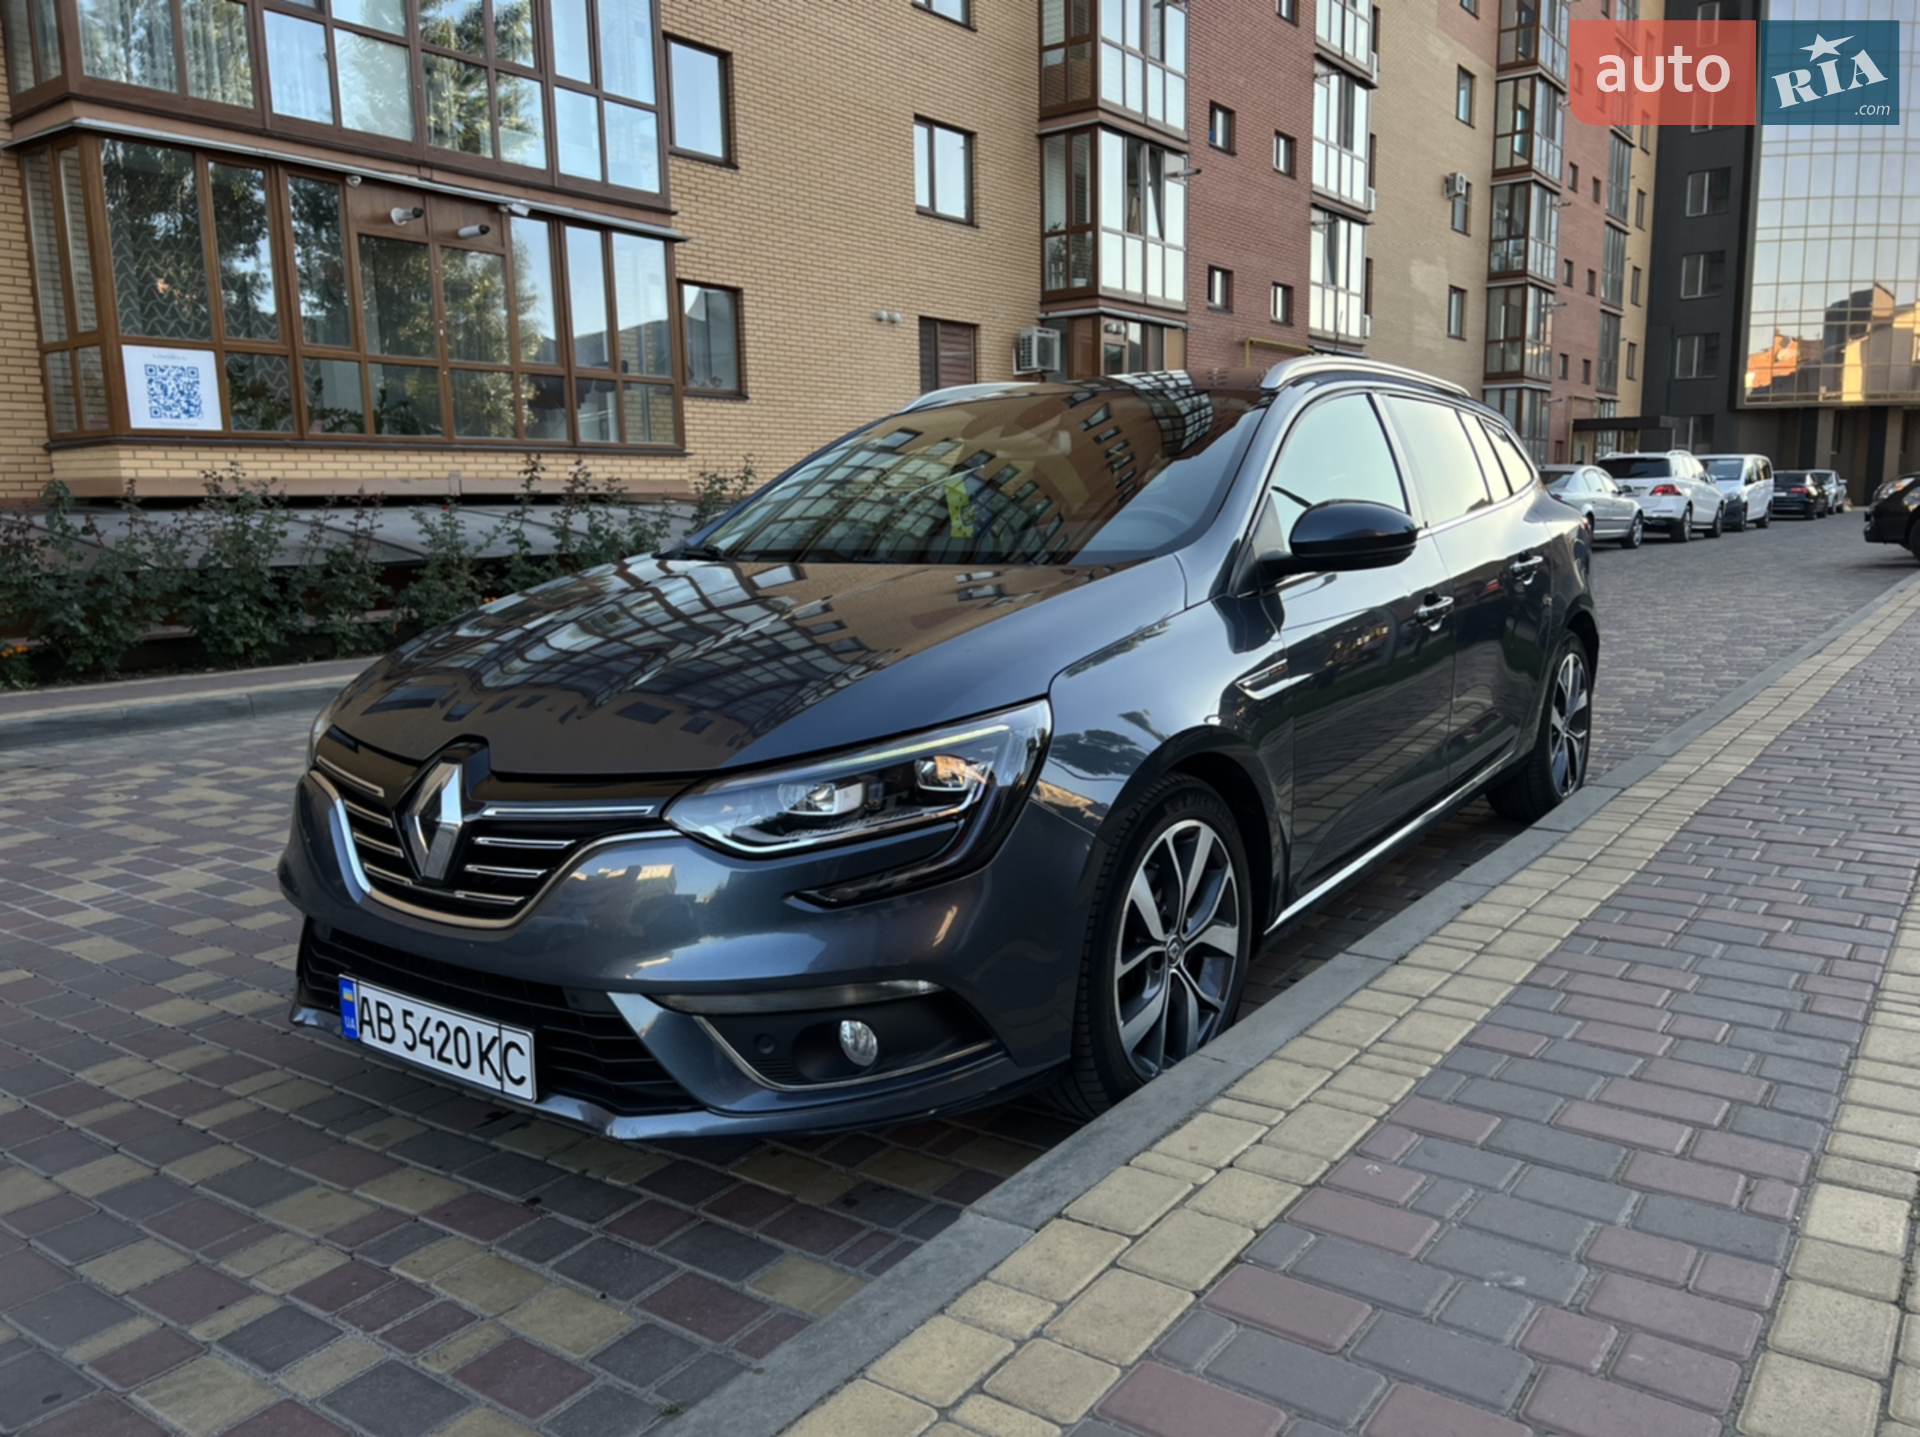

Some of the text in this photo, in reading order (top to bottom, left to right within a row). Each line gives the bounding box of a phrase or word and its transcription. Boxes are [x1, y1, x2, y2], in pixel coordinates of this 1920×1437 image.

[344, 1014, 356, 1029] UA
[359, 996, 527, 1086] AB 5420 KC
